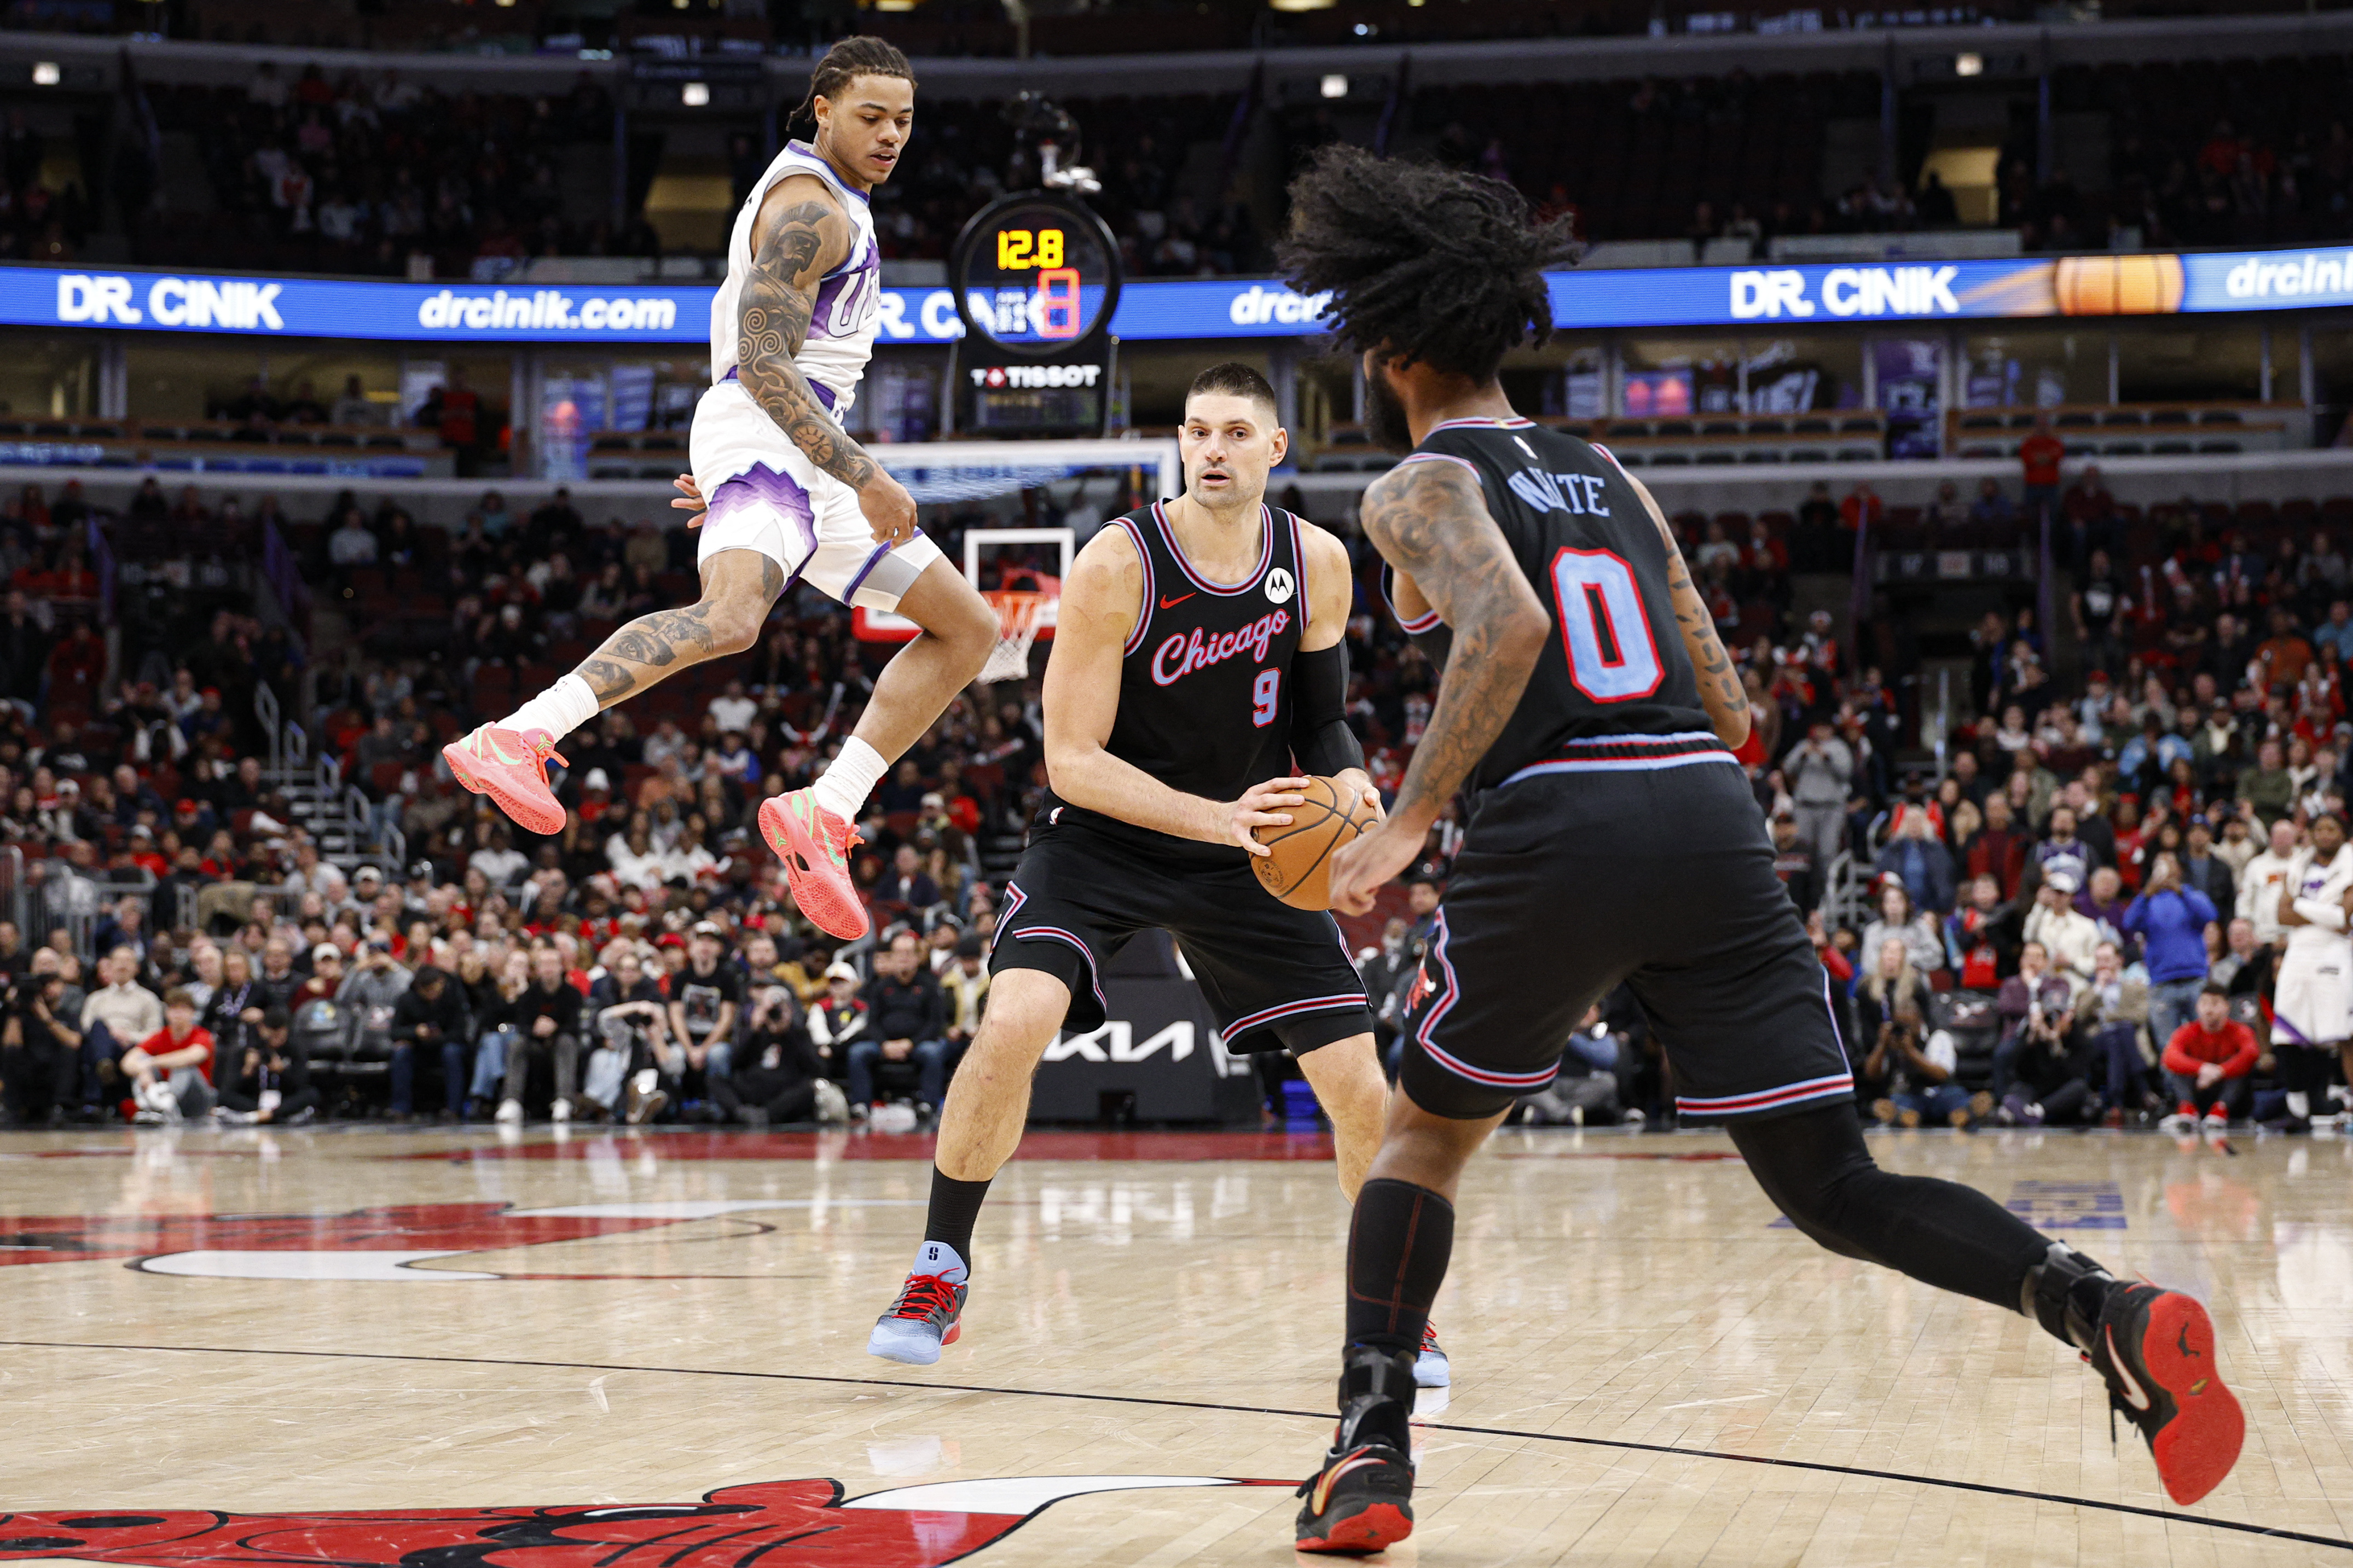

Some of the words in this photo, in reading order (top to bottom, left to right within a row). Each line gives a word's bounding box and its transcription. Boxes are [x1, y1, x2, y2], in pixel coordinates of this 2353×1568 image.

[998, 229, 1064, 270] 12.8
[57, 274, 142, 324] DR.
[148, 277, 285, 330] CINIK
[418, 289, 677, 329] drcinik.com
[1730, 268, 1814, 318] DR.
[1822, 266, 1960, 317] CINIK
[1005, 365, 1101, 388] TISSOT
[1151, 608, 1290, 686] Chicago
[1549, 546, 1665, 704] 0
[1252, 667, 1281, 728] 9
